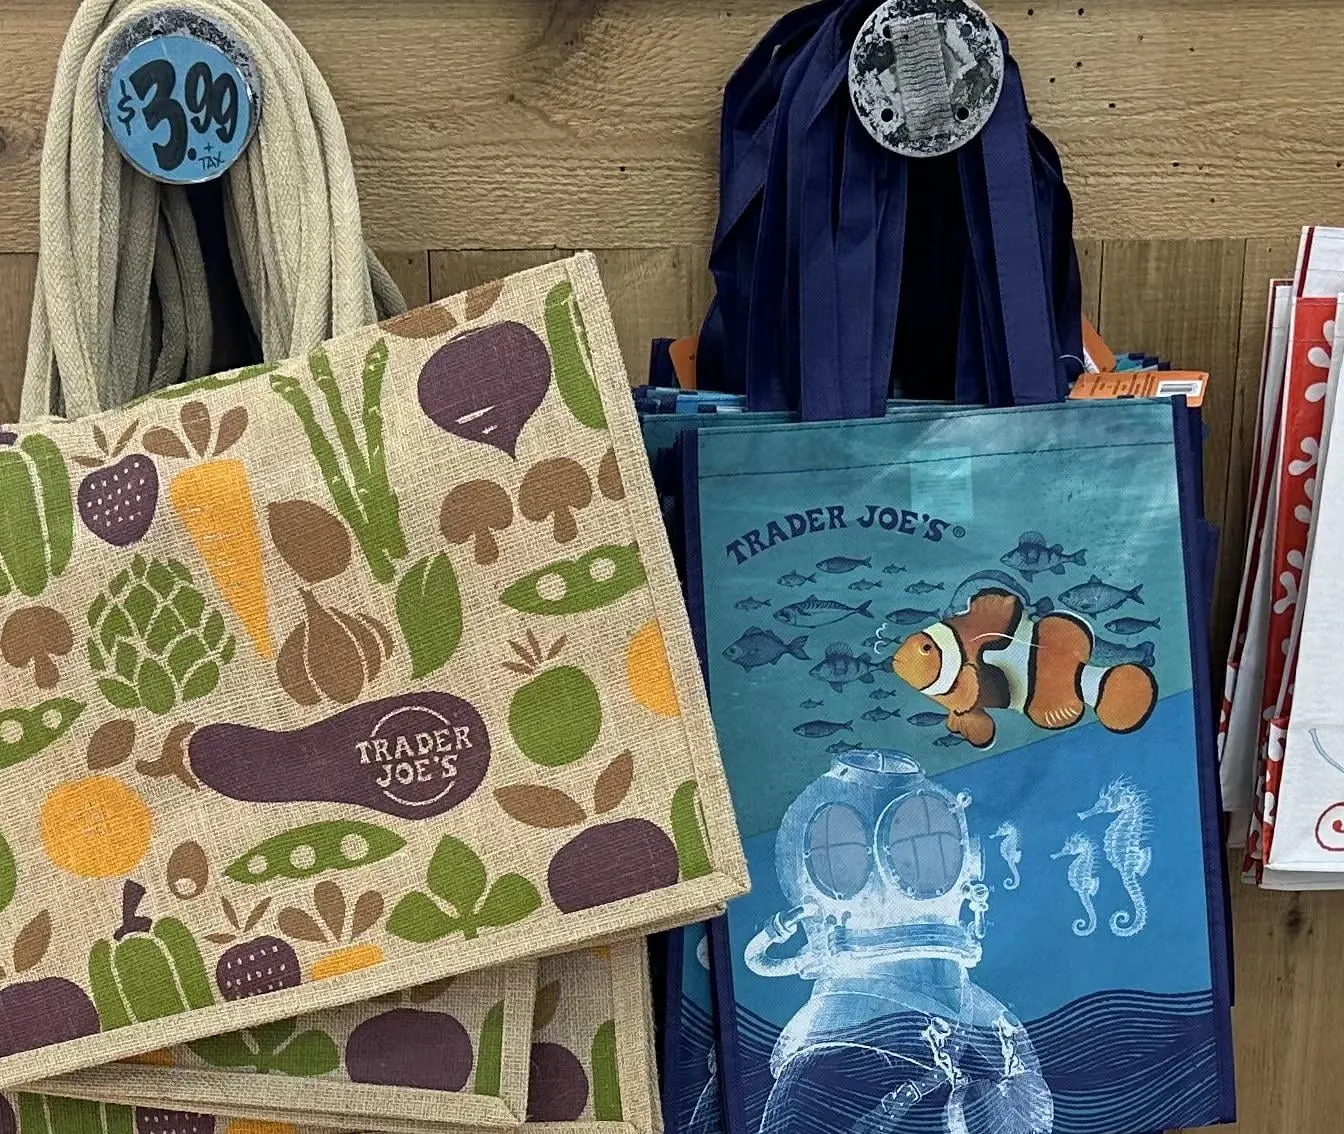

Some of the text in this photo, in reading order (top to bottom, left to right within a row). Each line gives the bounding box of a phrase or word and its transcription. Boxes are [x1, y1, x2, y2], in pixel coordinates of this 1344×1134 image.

[117, 59, 239, 171] $3.99
[199, 153, 225, 170] TAX
[726, 504, 848, 565] TRADER
[356, 726, 473, 764] TRADER
[376, 754, 459, 788] JOE'S
